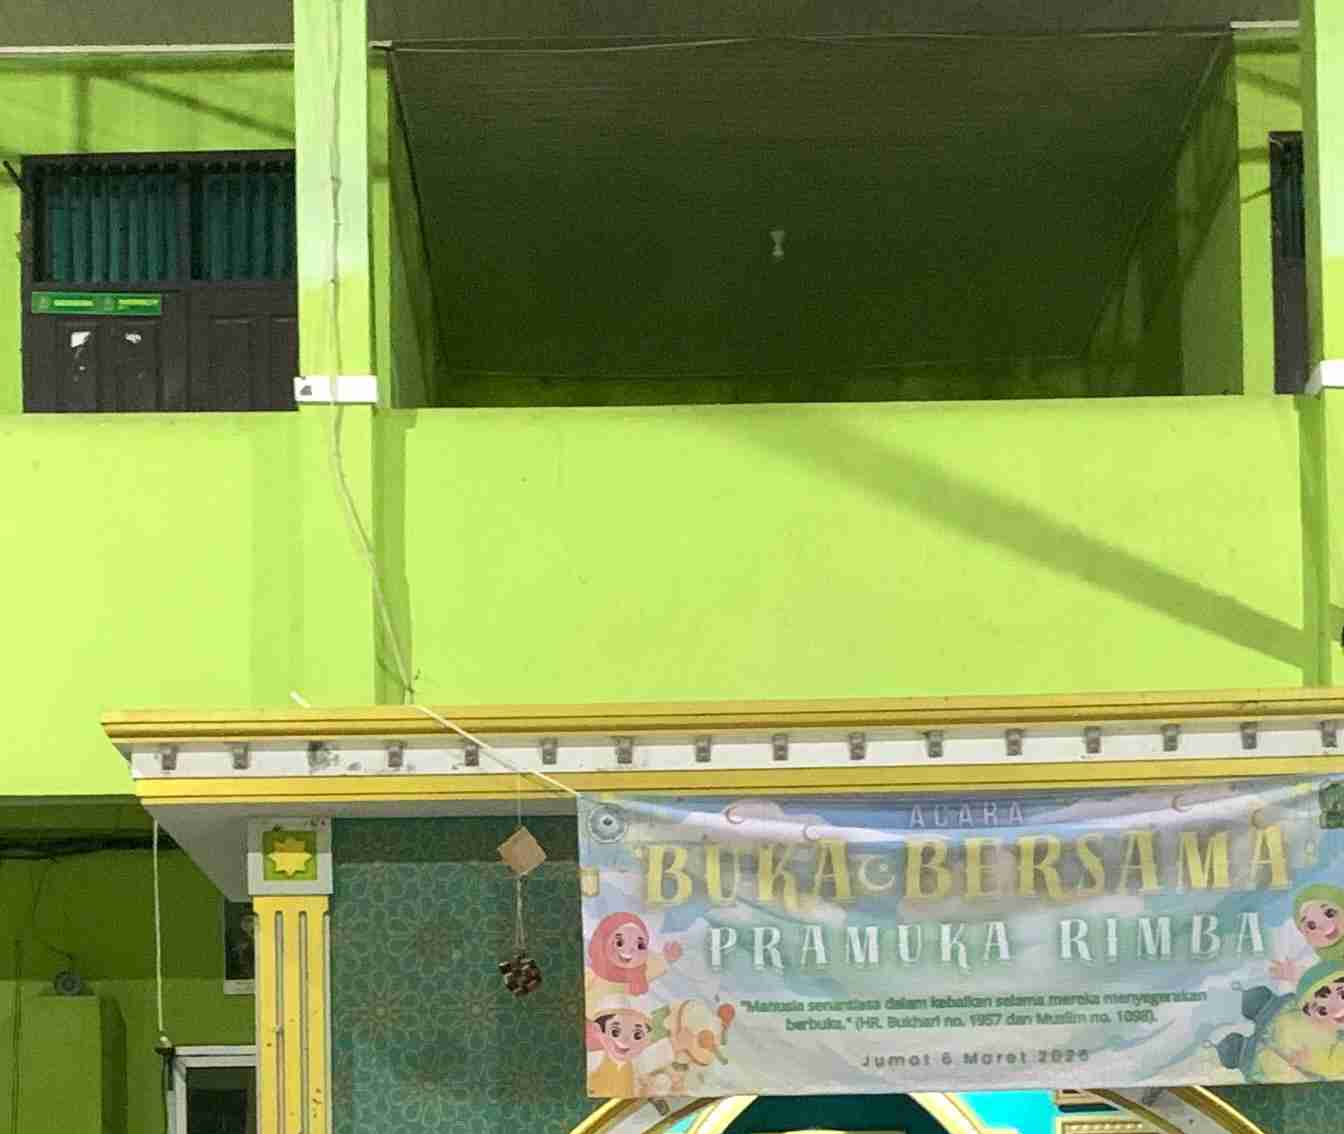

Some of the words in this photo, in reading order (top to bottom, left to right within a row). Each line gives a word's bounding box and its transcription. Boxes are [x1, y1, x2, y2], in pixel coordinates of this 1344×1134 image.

[909, 801, 1026, 828] ACARA
[644, 838, 854, 913] BUKA
[905, 823, 1291, 900] BERSAMA
[709, 920, 1012, 971] PRAMUKA
[1059, 911, 1266, 961] RIMBA
[884, 996, 926, 1010] dalam
[887, 1014, 940, 1029] Bukhari
[1006, 1012, 1033, 1026] dan
[1035, 1010, 1087, 1025] Muslim
[861, 1051, 931, 1068] Jumat
[941, 1051, 954, 1066] 6
[962, 1050, 1027, 1066] Maret
